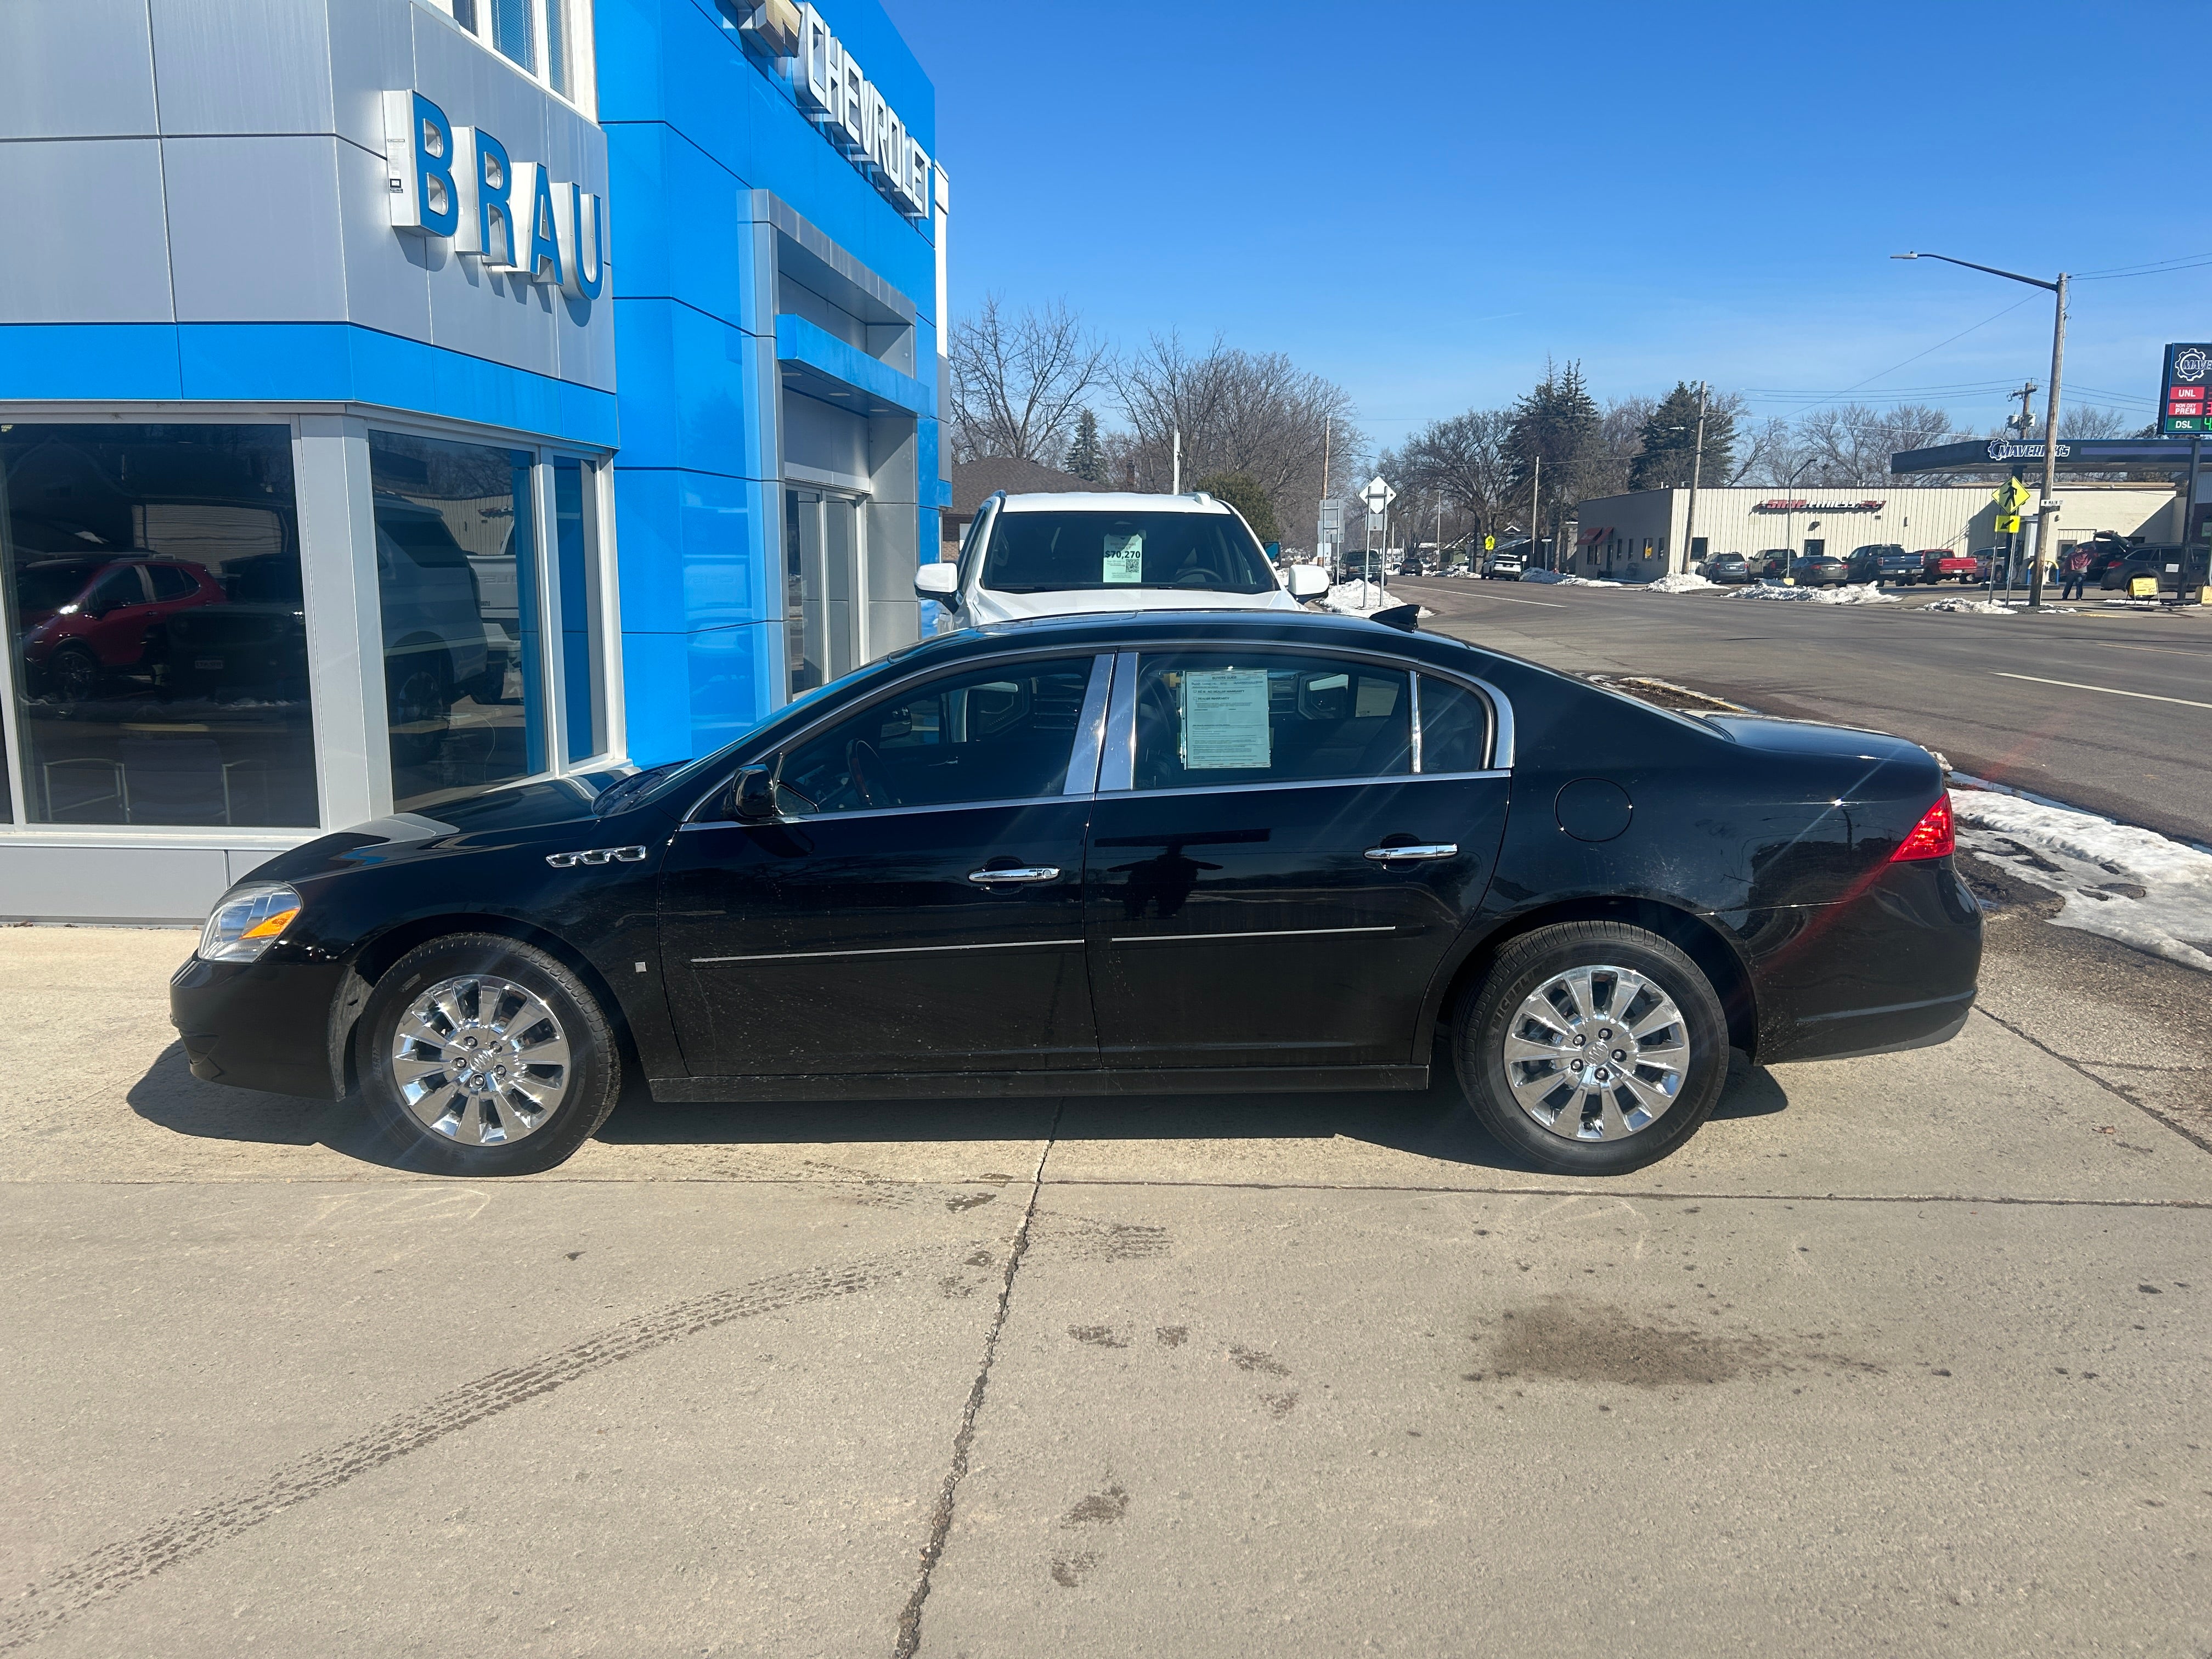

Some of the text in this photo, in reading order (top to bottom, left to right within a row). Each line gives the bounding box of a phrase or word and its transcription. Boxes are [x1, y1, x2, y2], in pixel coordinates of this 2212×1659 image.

[803, 2, 932, 219] CHEVROLET
[407, 89, 603, 300] BRAU
[2179, 389, 2196, 397] UNL
[2175, 420, 2192, 428] DSL
[1105, 550, 1141, 560] $70,270
[1490, 963, 1545, 1030] MICHELIN
